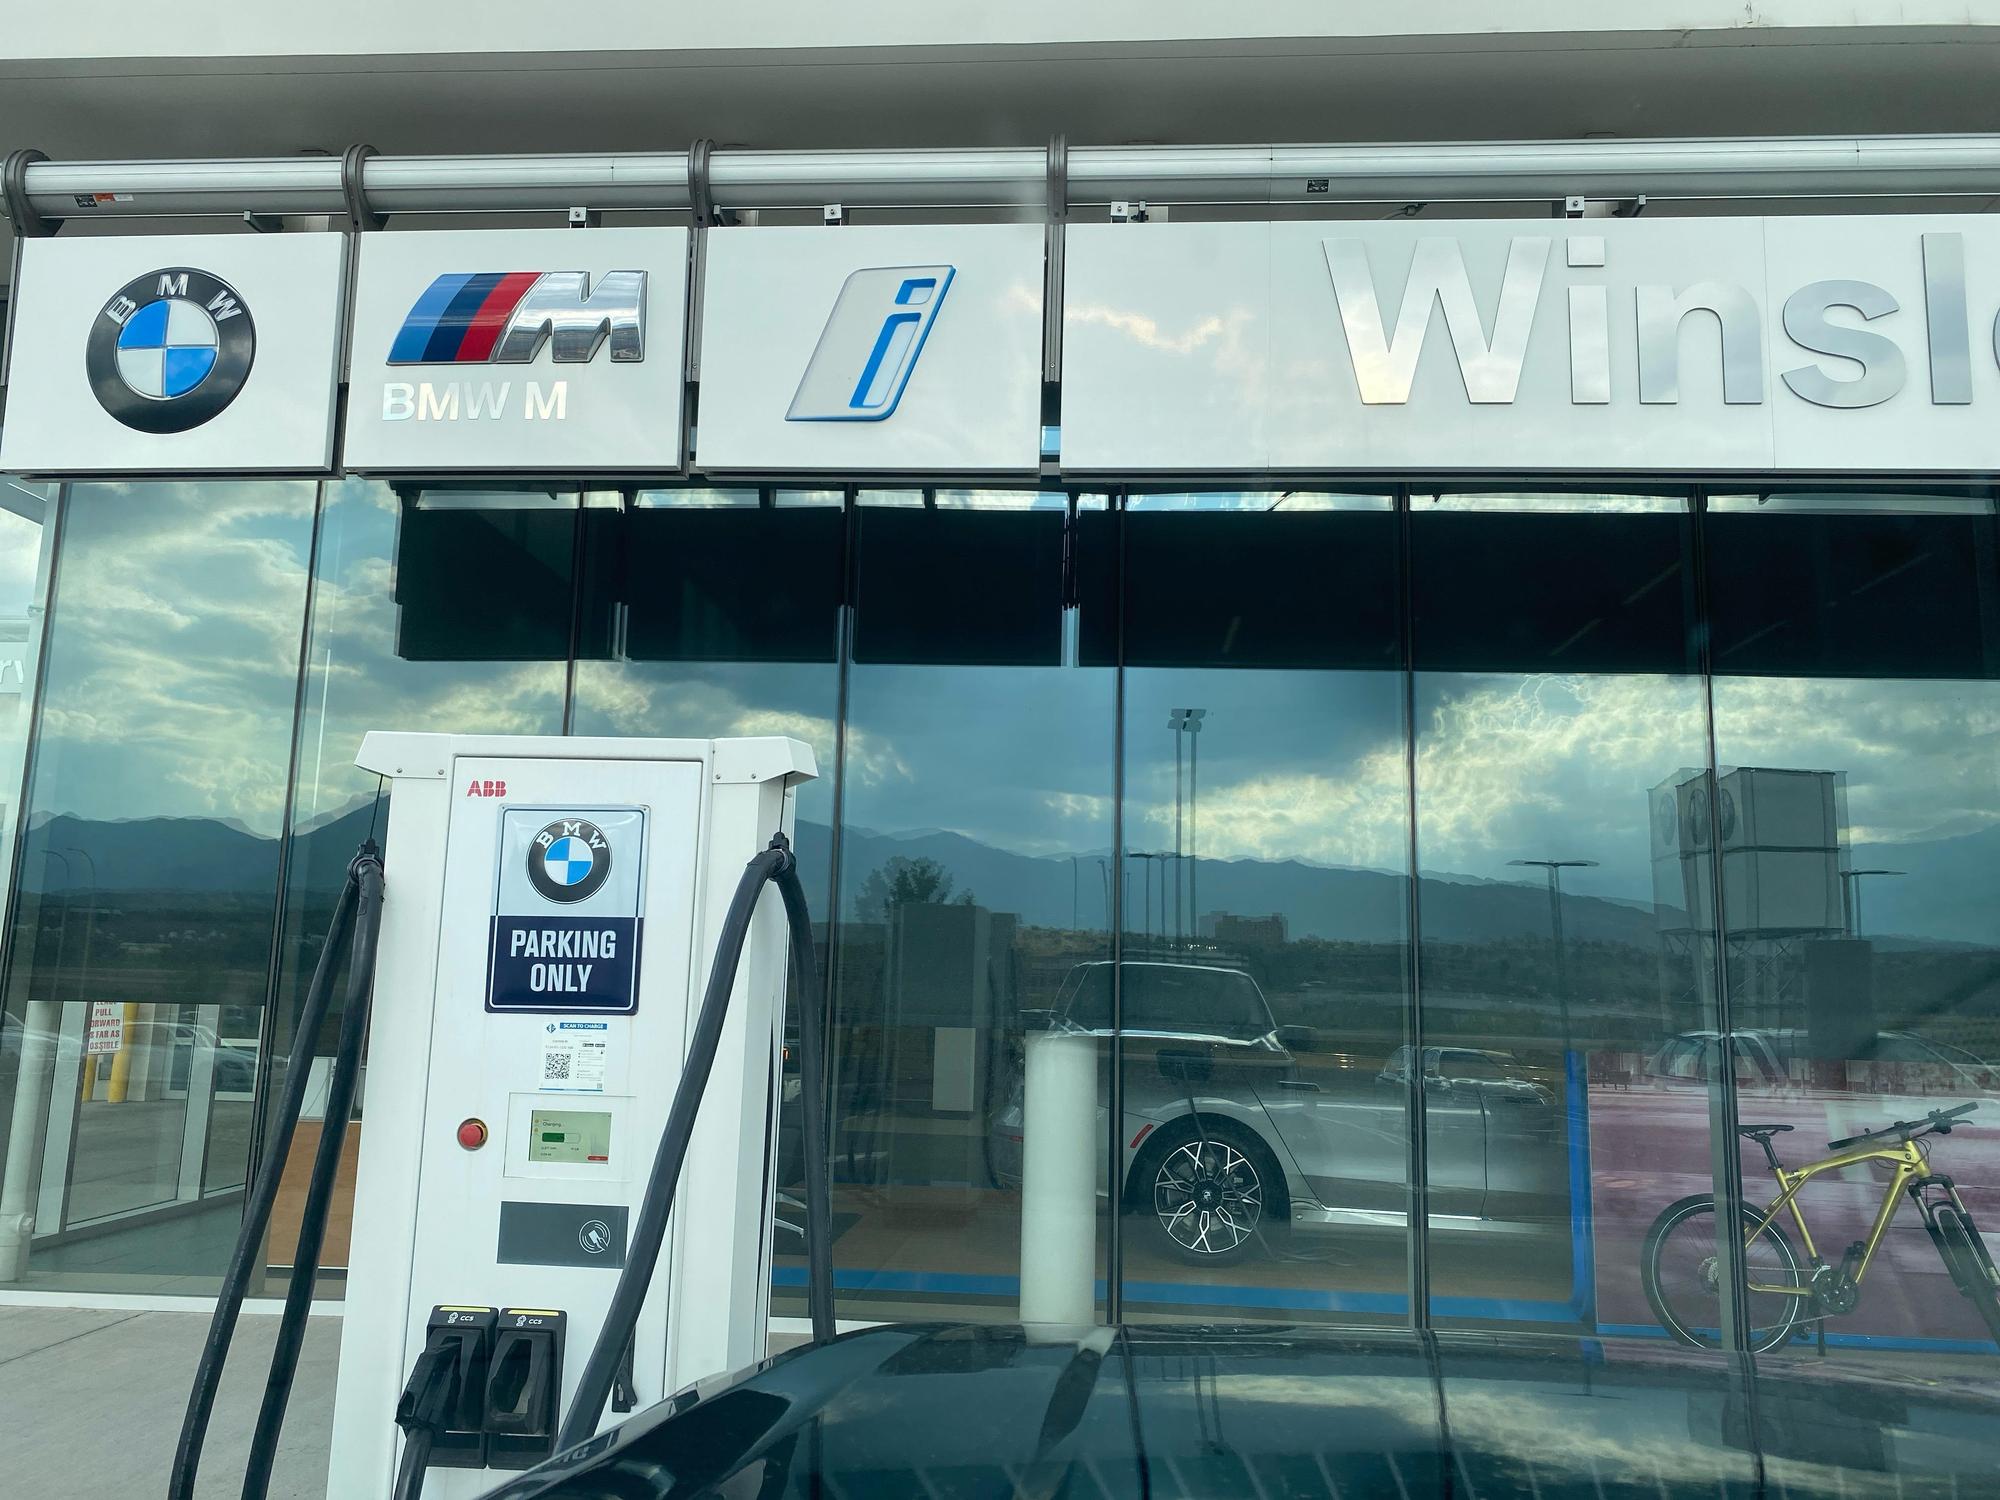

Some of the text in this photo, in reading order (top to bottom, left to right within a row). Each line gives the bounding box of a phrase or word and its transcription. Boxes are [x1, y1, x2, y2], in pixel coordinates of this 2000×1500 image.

[105, 273, 242, 327] BMW
[490, 270, 648, 365] M
[1321, 231, 2000, 409] Winsl
[382, 380, 568, 421] BMW M
[467, 780, 507, 797] ABB
[536, 821, 607, 849] BMW
[510, 929, 617, 959] PARKING
[530, 963, 593, 992] ONLY
[90, 1019, 120, 1027] ORWARD
[95, 1008, 112, 1016] PULL
[90, 1041, 118, 1050] OSSIBLE
